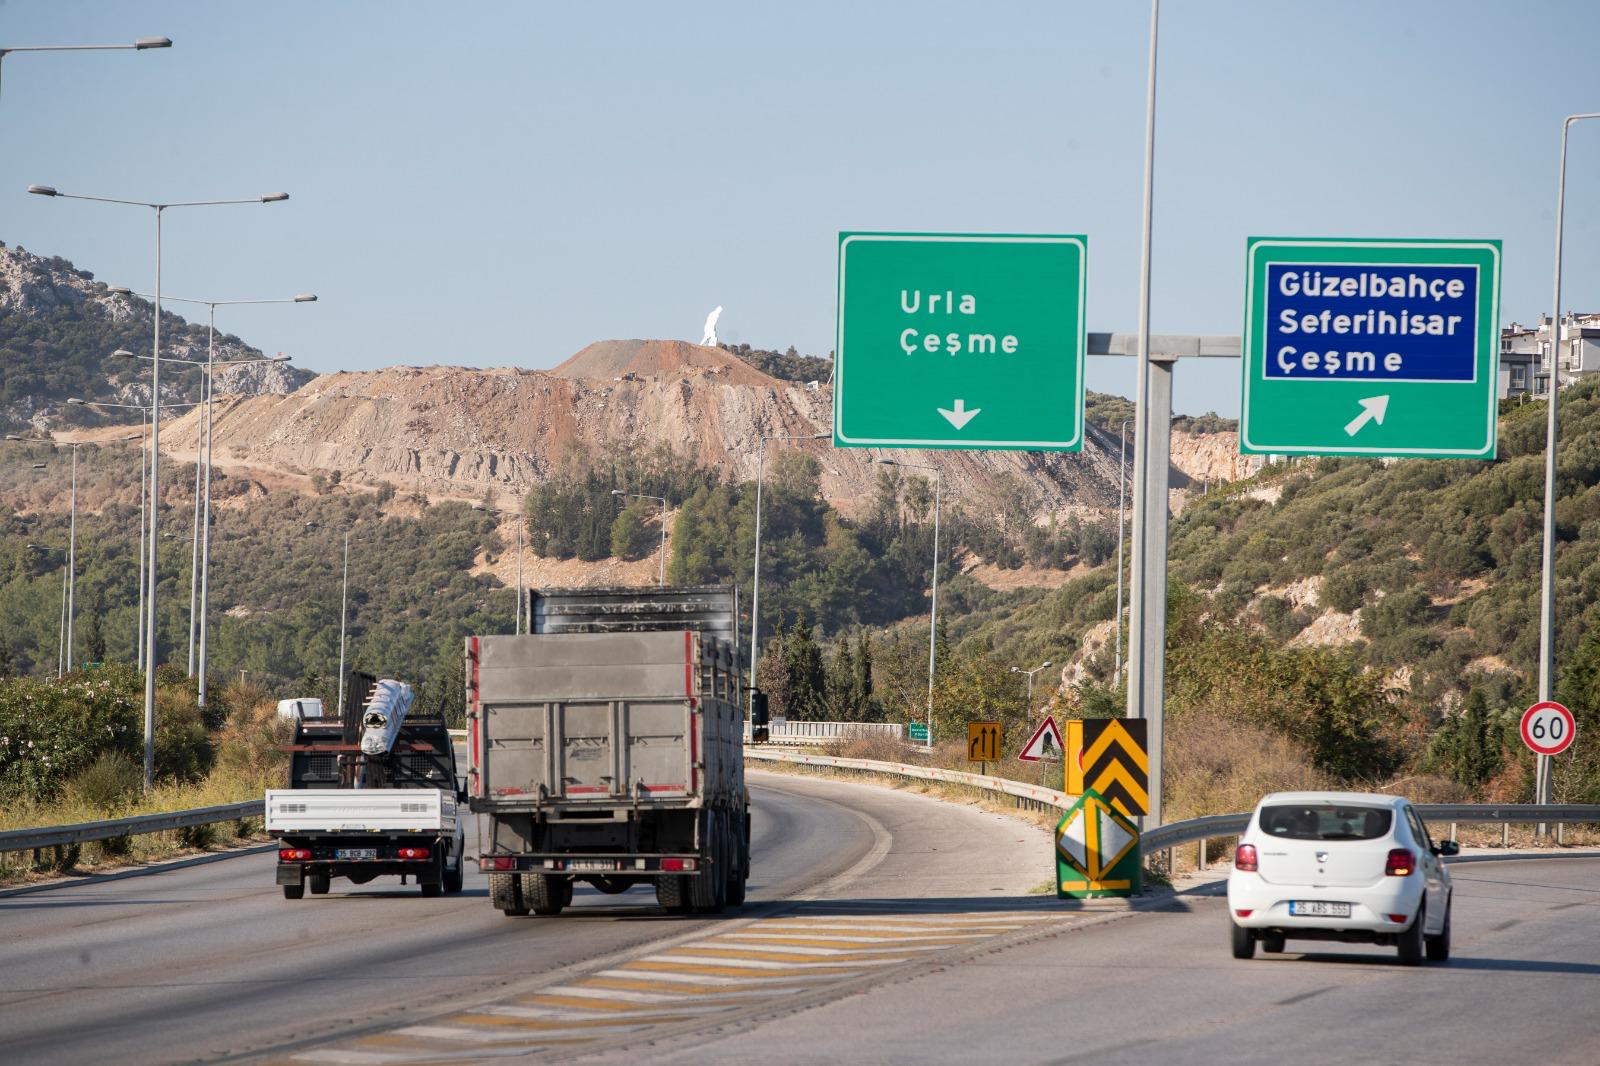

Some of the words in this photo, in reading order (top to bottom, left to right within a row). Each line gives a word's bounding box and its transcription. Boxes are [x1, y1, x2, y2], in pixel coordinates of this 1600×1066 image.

[1279, 271, 1465, 302] Güzelbahçe
[900, 290, 977, 315] Urla
[1278, 309, 1463, 336] Seferihisar
[899, 327, 1019, 357] Çeşme
[1277, 346, 1403, 375] Çeşme
[1533, 717, 1563, 740] 60
